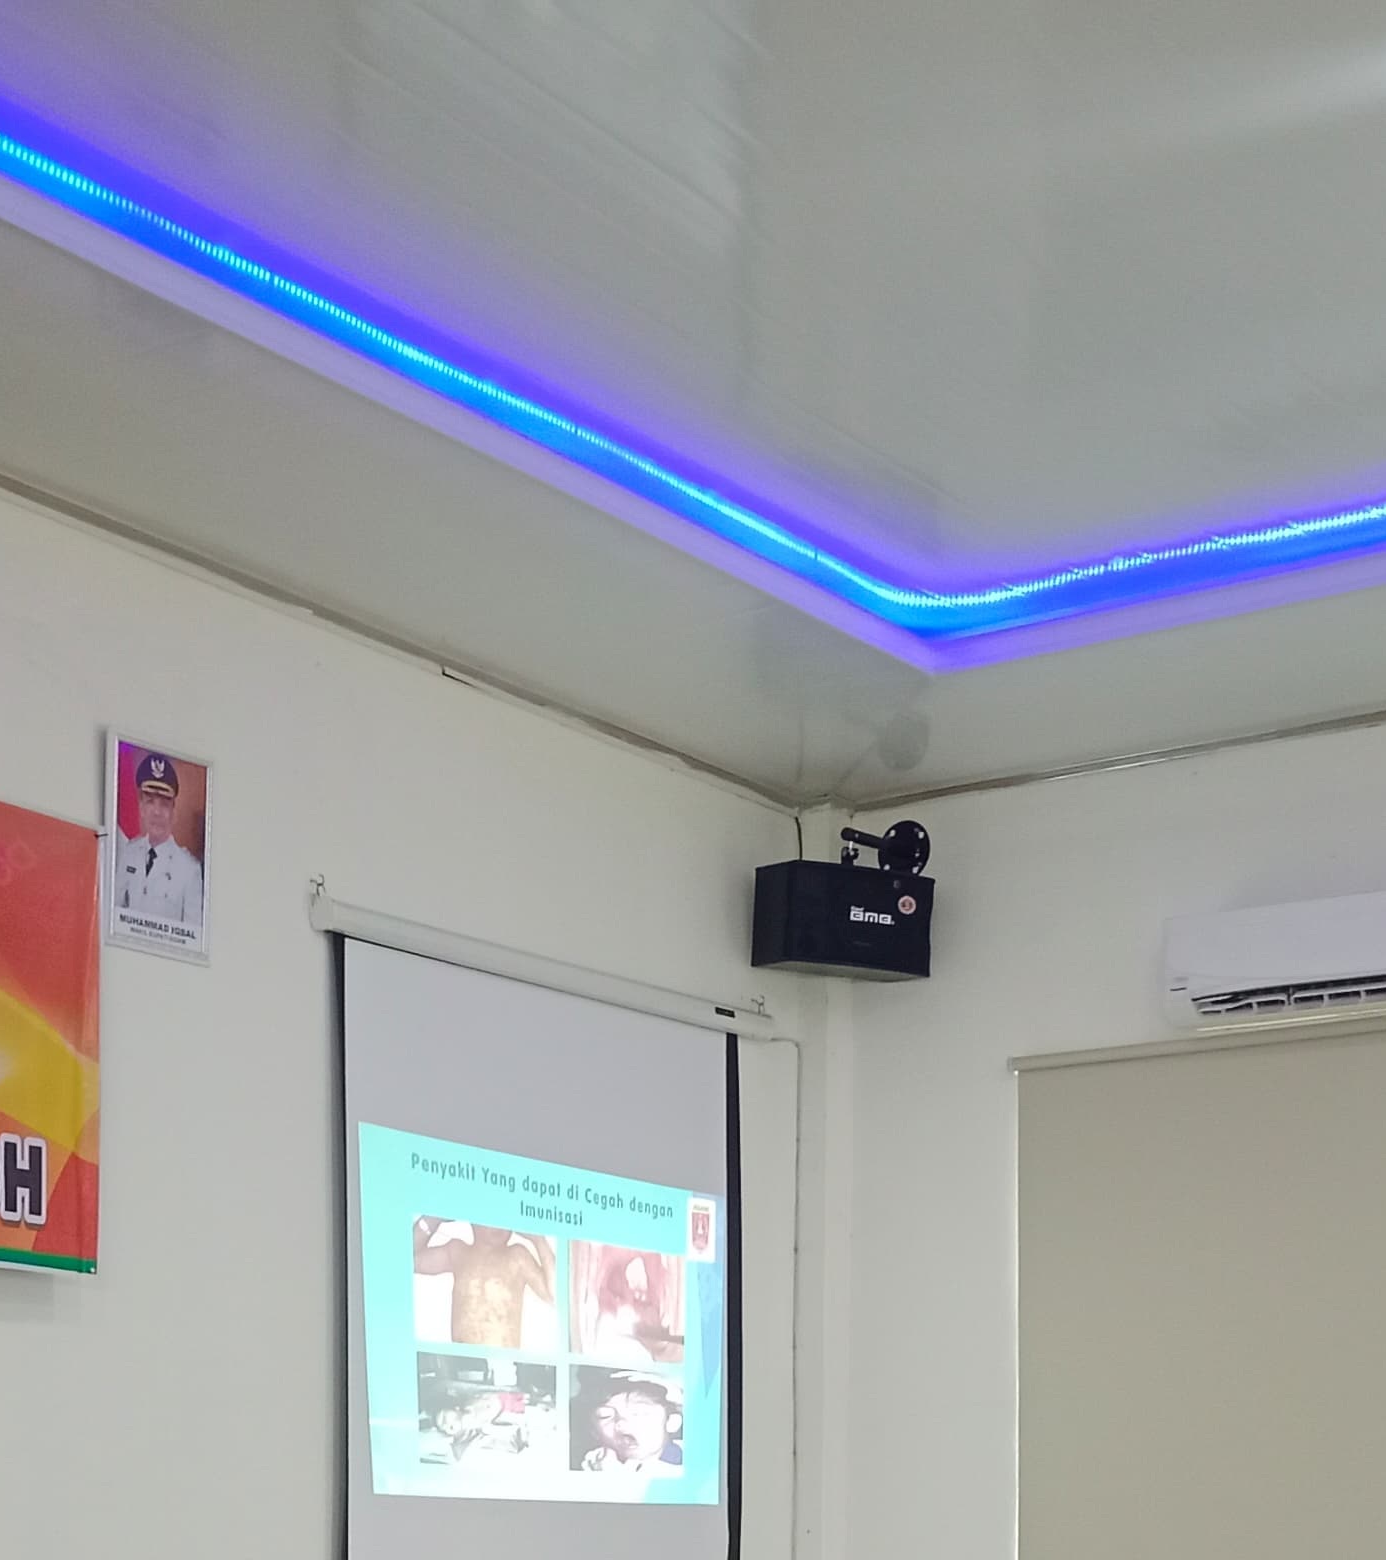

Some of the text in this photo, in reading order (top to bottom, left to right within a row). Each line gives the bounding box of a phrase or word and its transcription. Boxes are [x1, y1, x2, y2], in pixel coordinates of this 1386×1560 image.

[411, 1153, 674, 1219] Penyakit Yang dapat di Cegah dengan
[520, 1201, 583, 1226] Imunisasi
